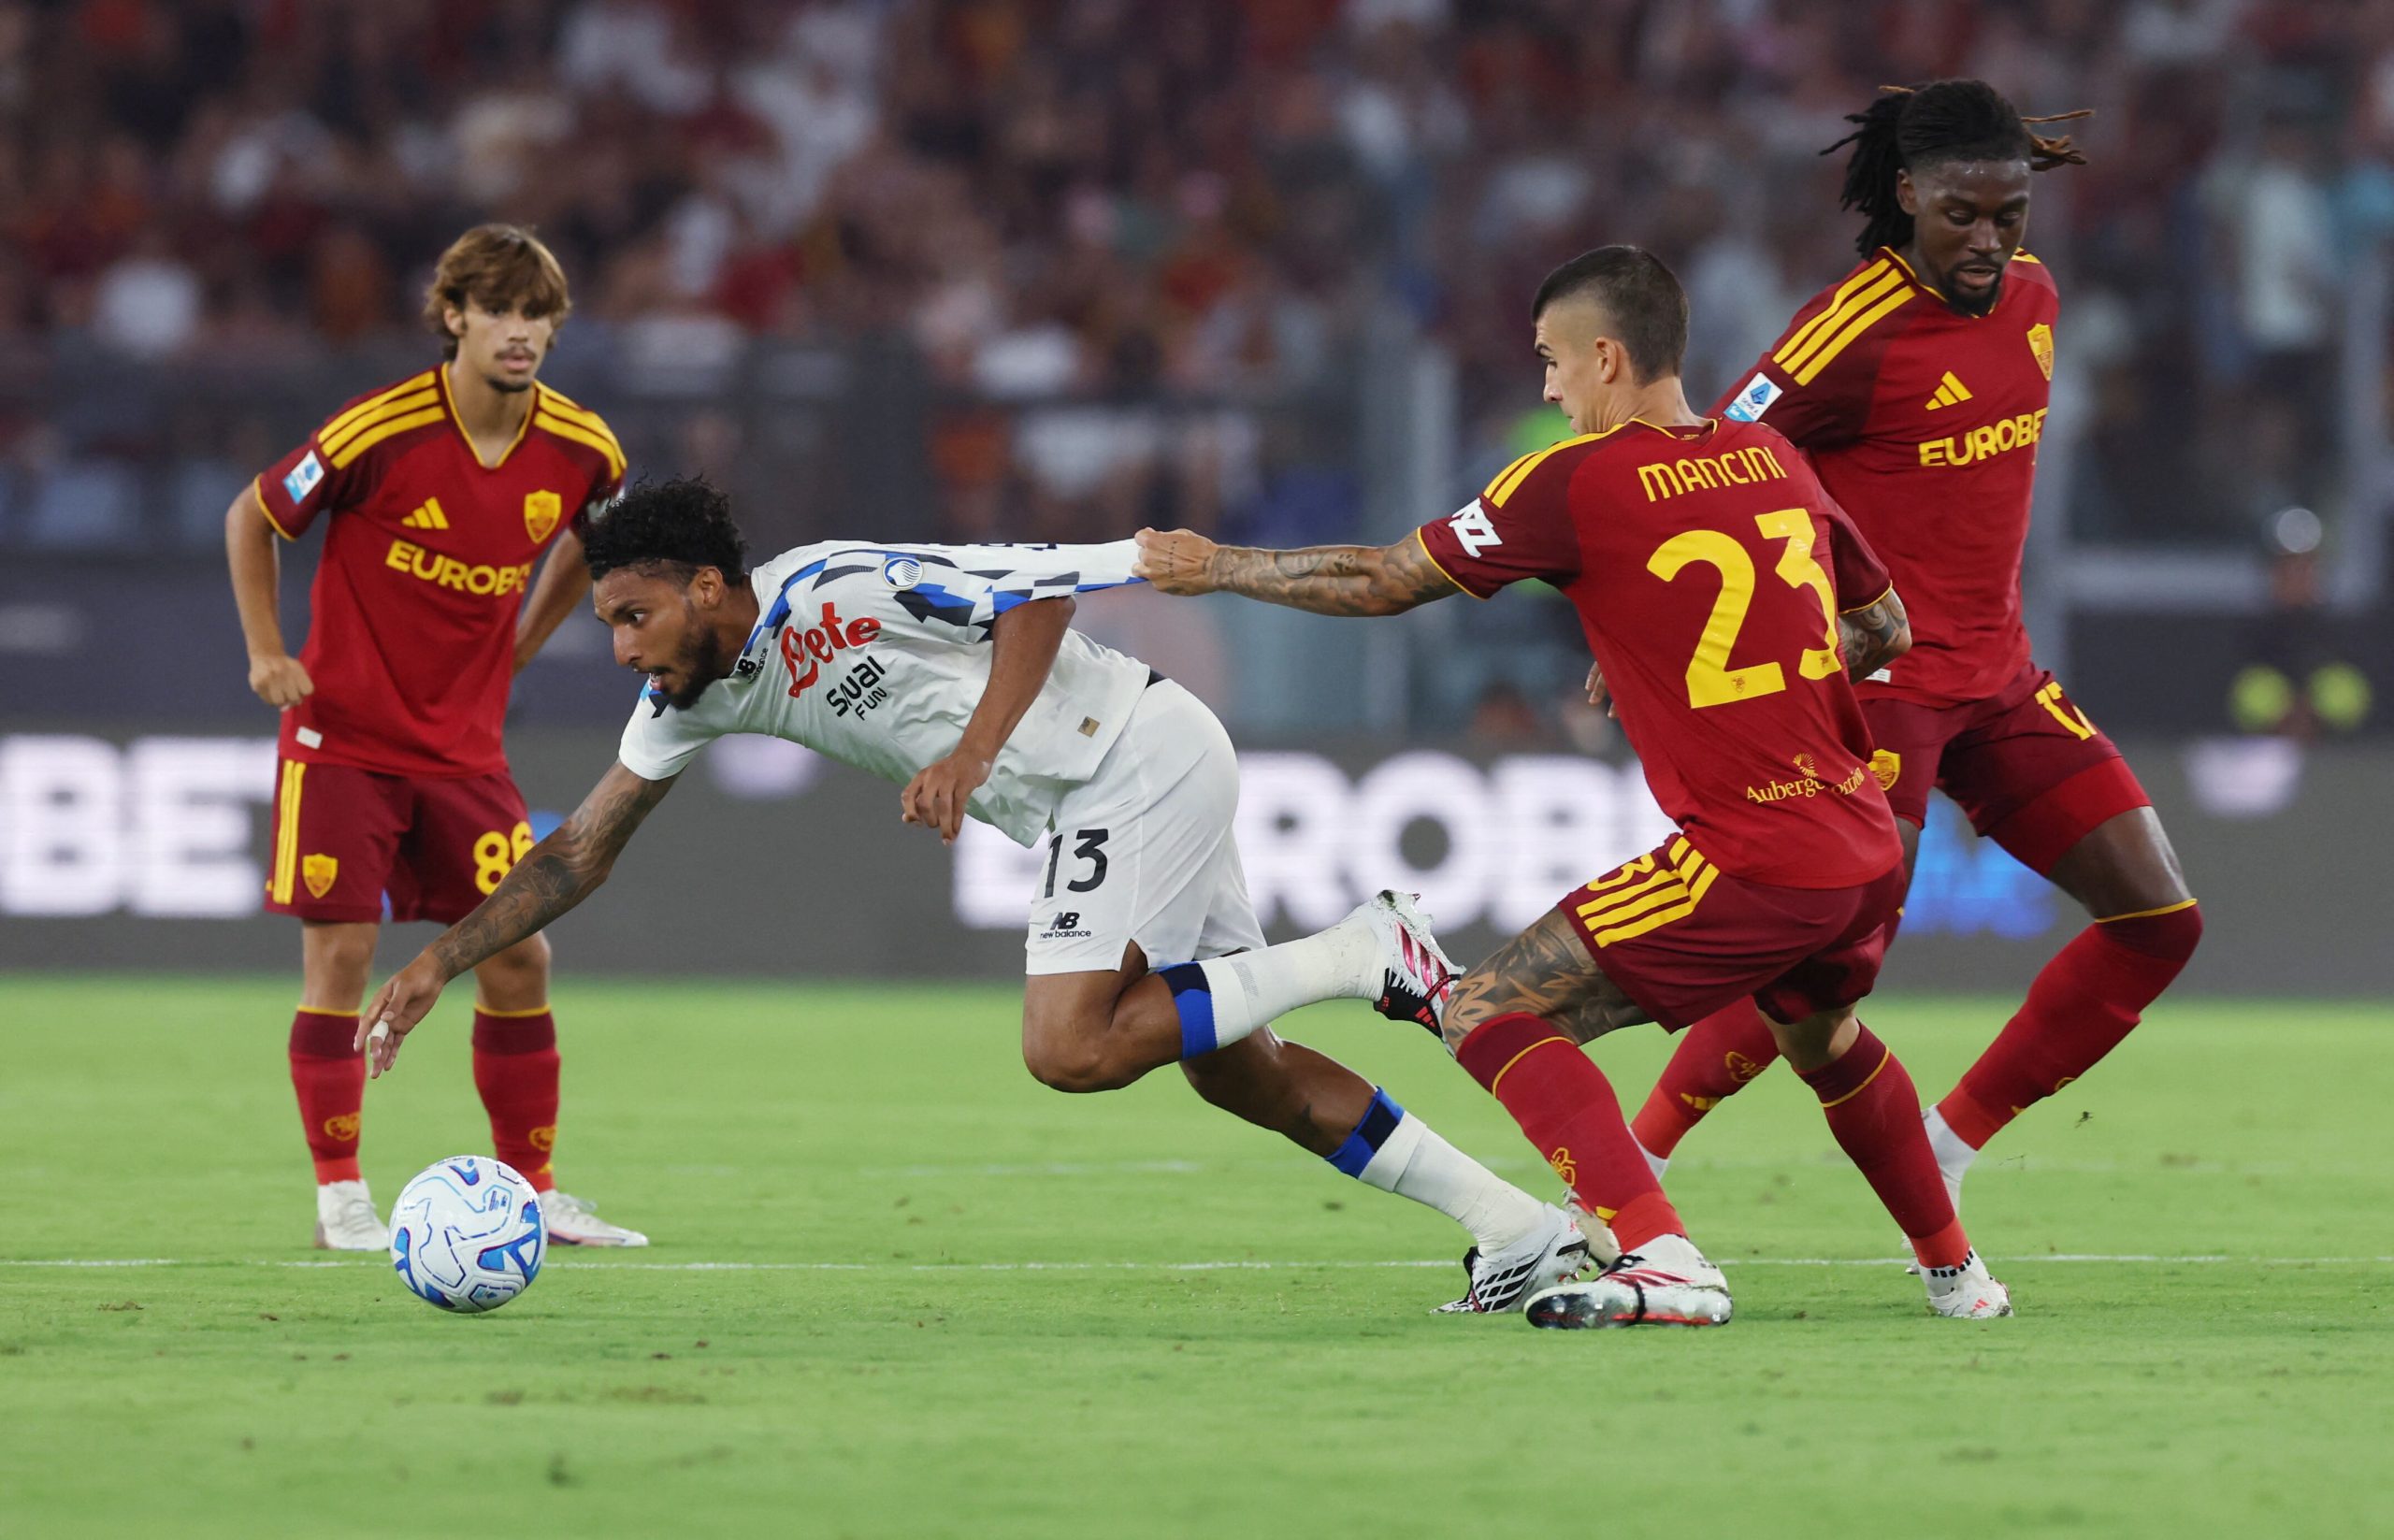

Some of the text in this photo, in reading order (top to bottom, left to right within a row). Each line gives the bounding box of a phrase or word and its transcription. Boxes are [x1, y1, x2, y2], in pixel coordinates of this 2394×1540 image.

[1637, 446, 1788, 503] MANCINI
[1646, 508, 1842, 710] 23
[780, 601, 882, 698] Lete
[855, 686, 887, 721] FUN
[0, 733, 278, 917] BE
[1044, 828, 1109, 899] 13
[1055, 929, 1092, 939] balance
